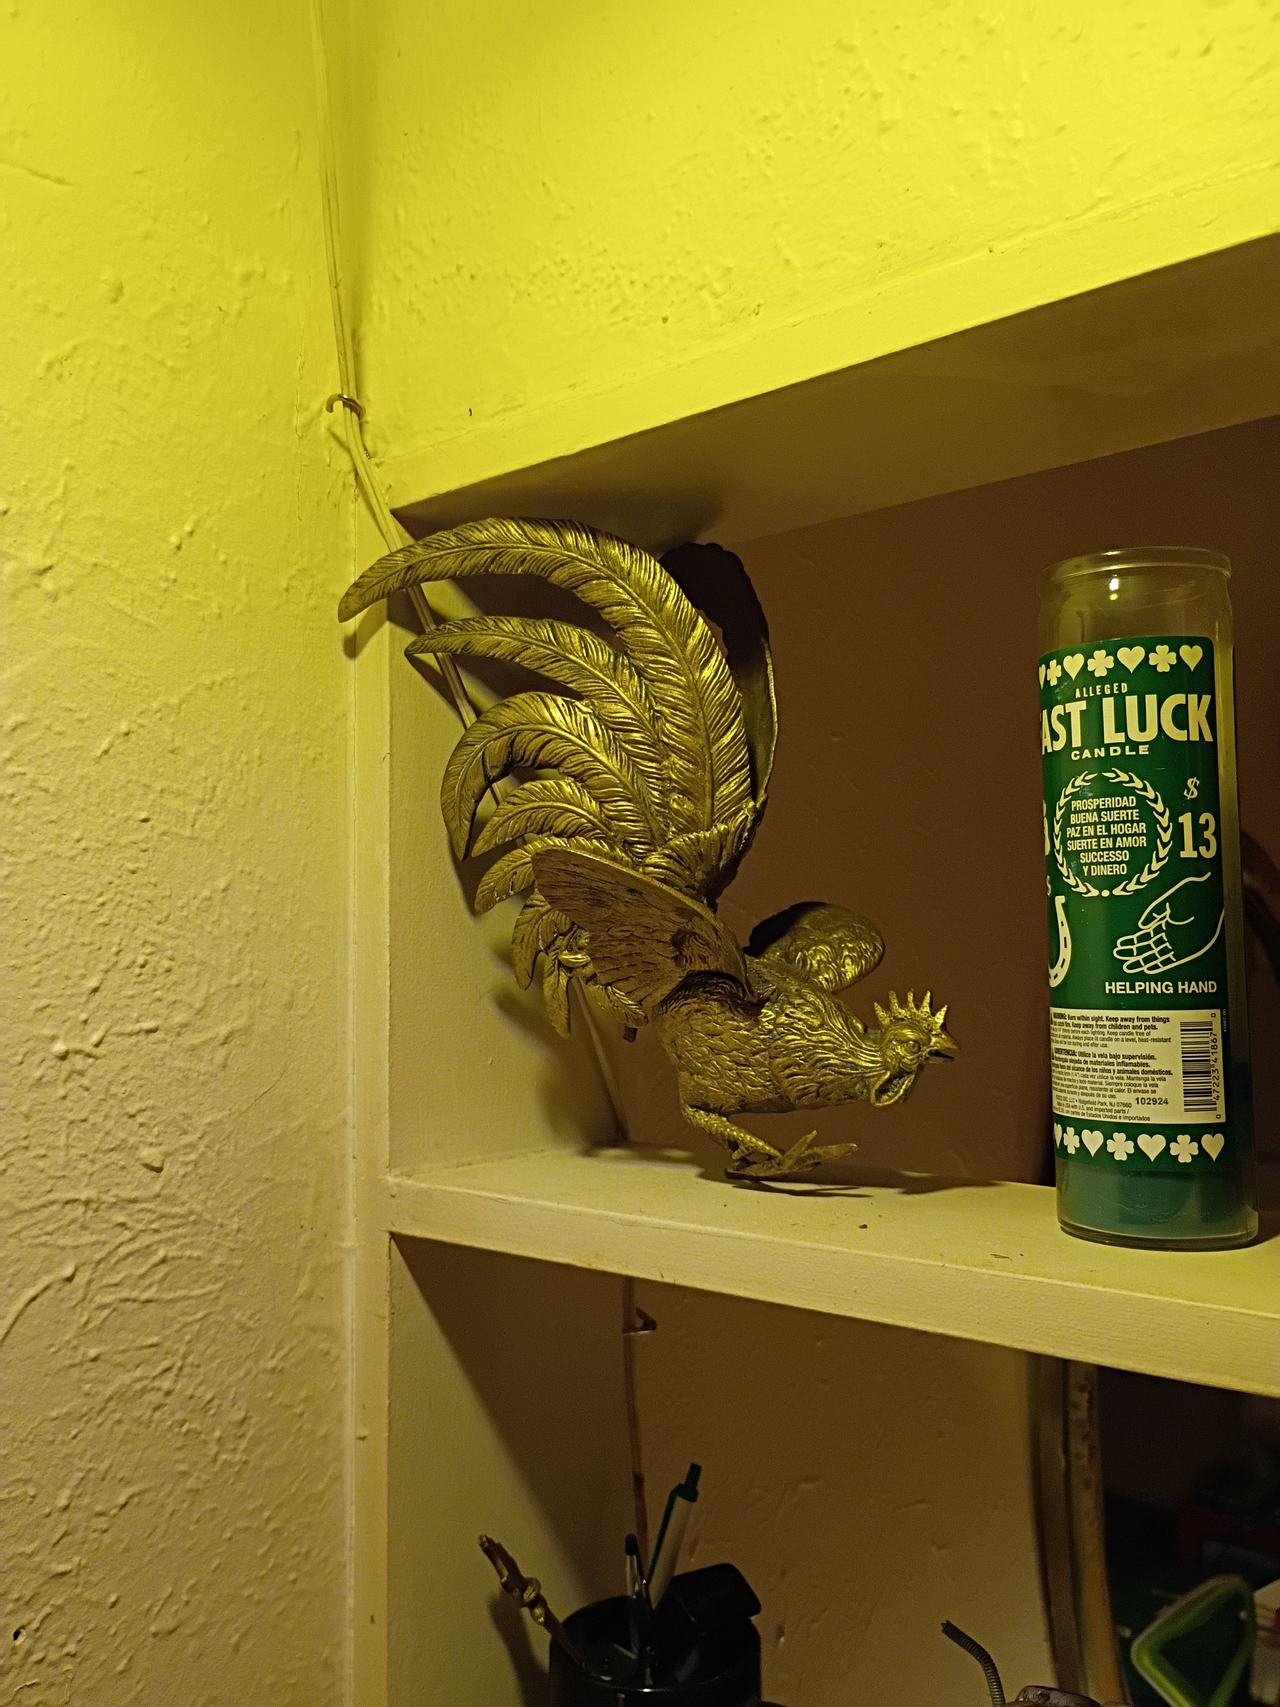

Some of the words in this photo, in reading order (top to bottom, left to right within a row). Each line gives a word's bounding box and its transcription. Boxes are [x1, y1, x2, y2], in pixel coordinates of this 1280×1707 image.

[1075, 682, 1128, 698] ALLEGED
[1040, 700, 1087, 755] AST
[1102, 693, 1214, 744] LUCK
[1071, 744, 1149, 760] CANDLE
[1183, 776, 1200, 799] $
[1071, 796, 1136, 811] PROSPERIDAD
[1070, 811, 1098, 824] BUENA
[1101, 809, 1140, 822] SUERTE
[1066, 826, 1081, 838] PAZ
[1082, 825, 1095, 837] EN
[1096, 824, 1108, 836] EL
[1110, 822, 1146, 836] HOGAR
[1178, 811, 1217, 859] 13
[1066, 838, 1098, 851] SUERTE
[1100, 837, 1113, 849] EN
[1115, 835, 1147, 848] AMOR
[1080, 850, 1129, 863] SUCCESSO
[1082, 866, 1090, 877] Y
[1091, 864, 1127, 876] DINERO
[1105, 982, 1173, 994] HELPING
[1178, 981, 1217, 993] HAND
[1135, 1097, 1169, 1105] 102924
[1123, 1113, 1150, 1121] importados
